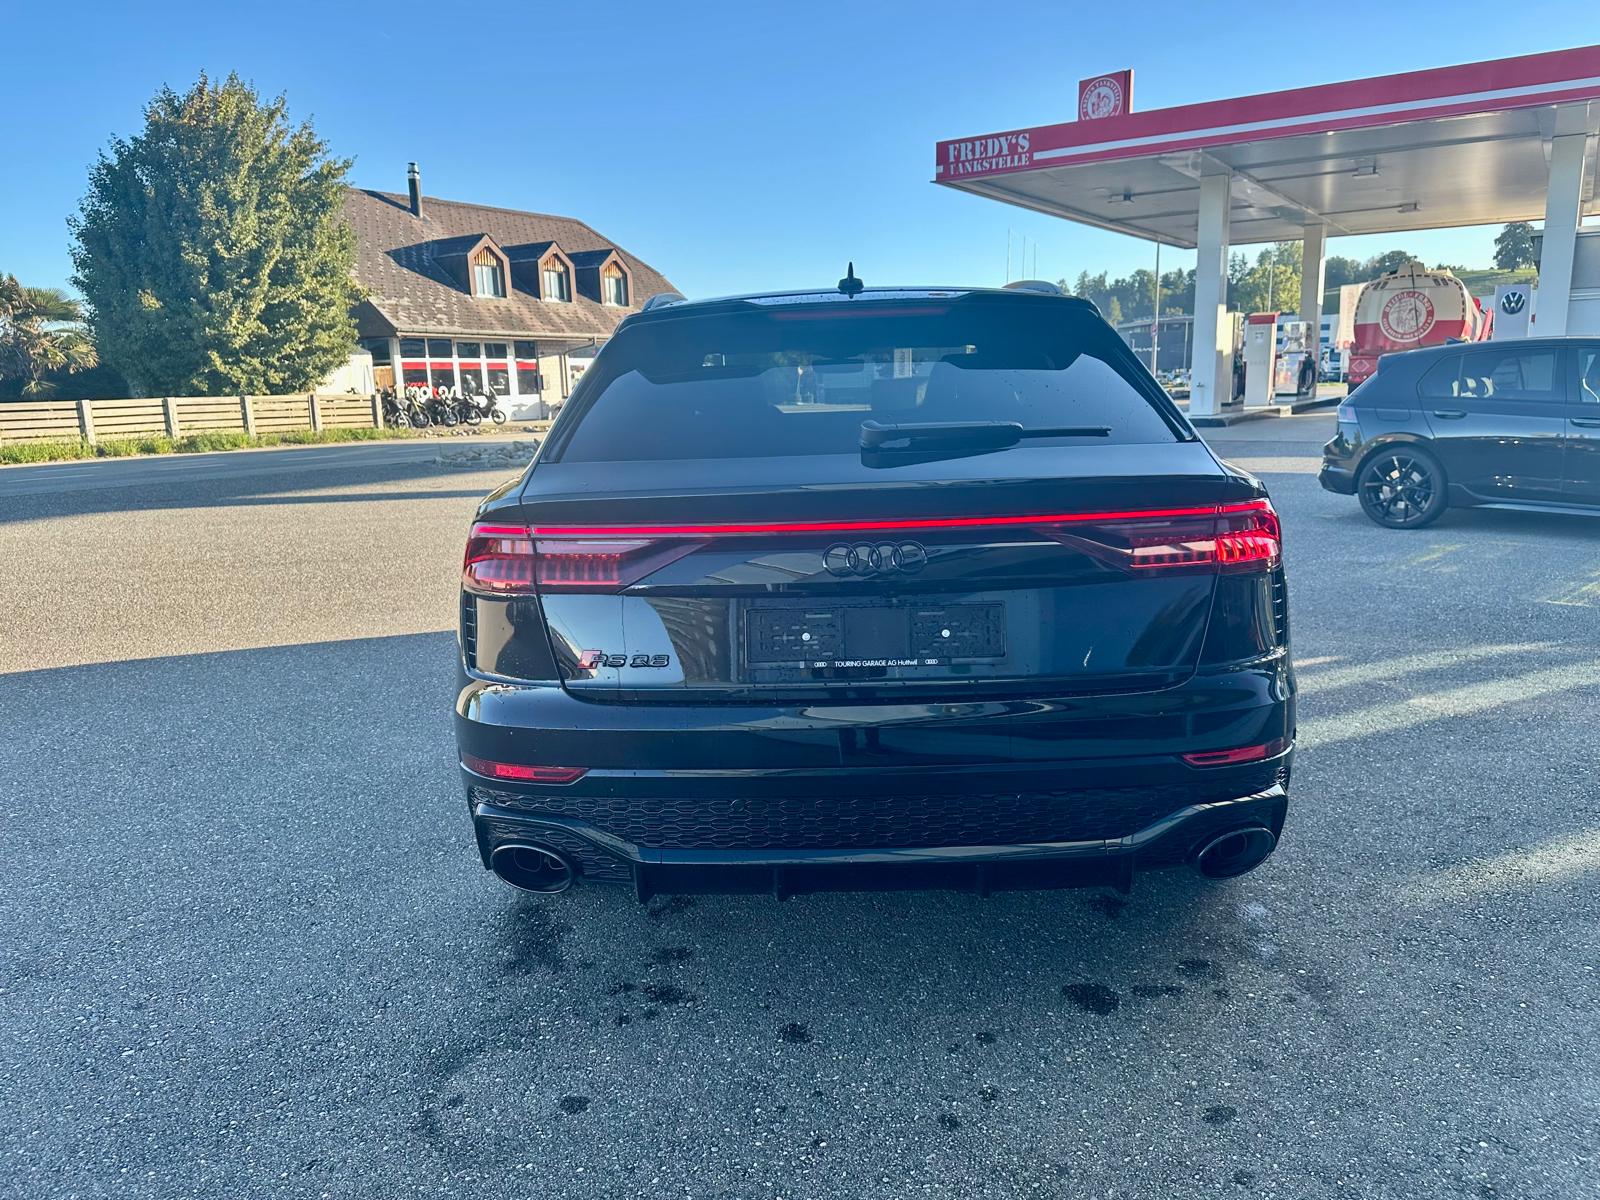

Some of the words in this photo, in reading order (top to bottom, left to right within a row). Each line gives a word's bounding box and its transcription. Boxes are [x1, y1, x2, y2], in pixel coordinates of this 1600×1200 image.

[948, 133, 1030, 162] FREDY'S
[949, 153, 1030, 175] TANKSTELLE
[582, 651, 627, 669] RS
[630, 654, 670, 668] Q8
